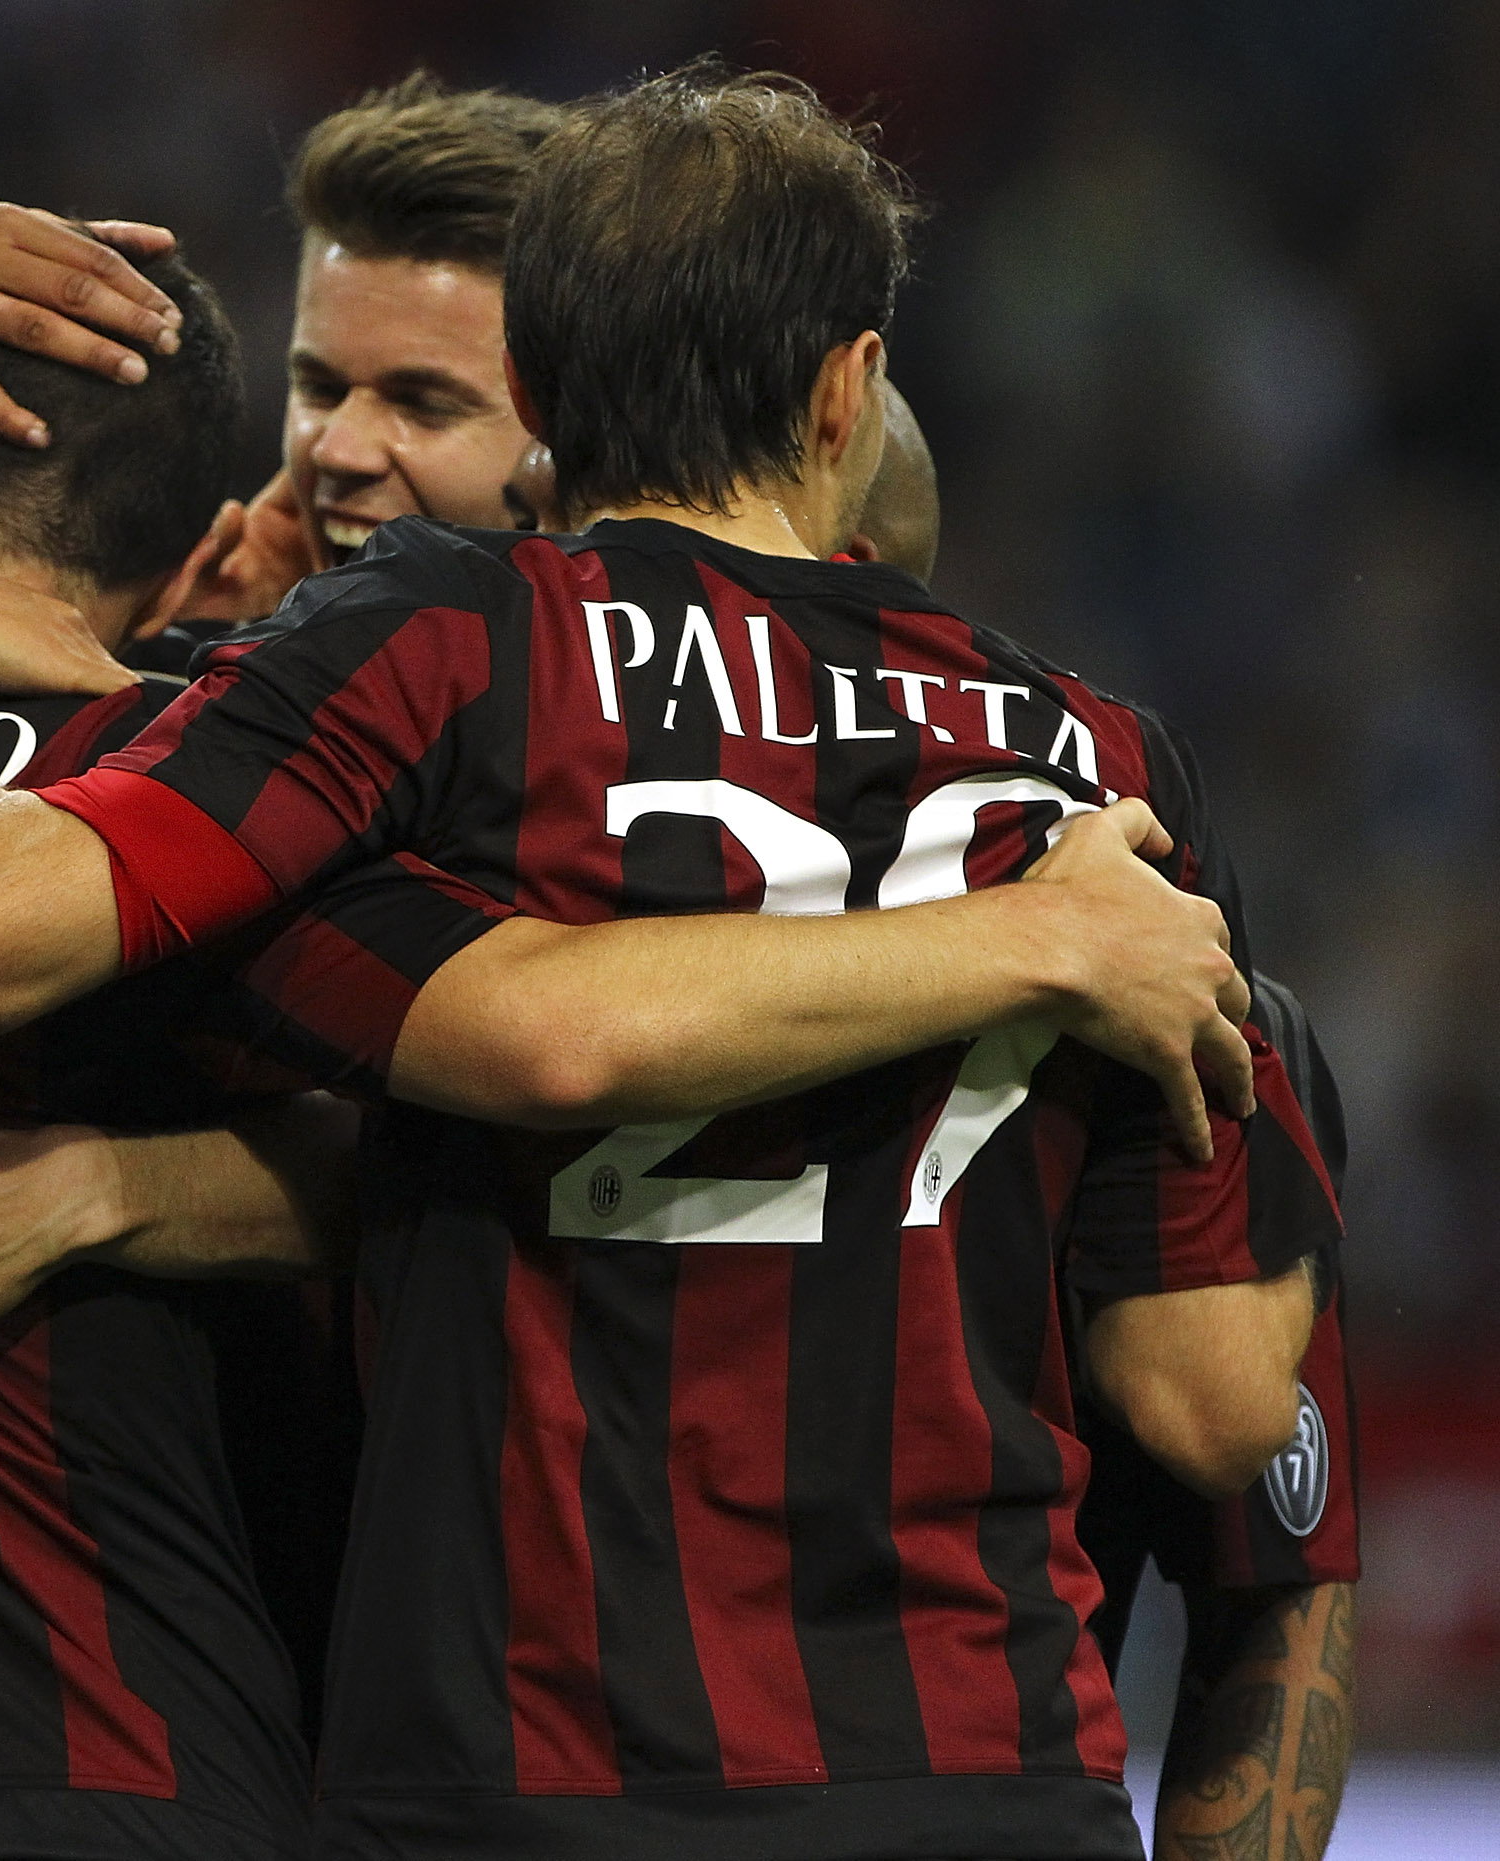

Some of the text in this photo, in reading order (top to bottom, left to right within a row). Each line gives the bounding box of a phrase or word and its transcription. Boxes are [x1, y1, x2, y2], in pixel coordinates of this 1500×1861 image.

[581, 600, 1119, 804] PALETTA
[548, 772, 1102, 1243] 29
[1286, 1453, 1303, 1493] 7
